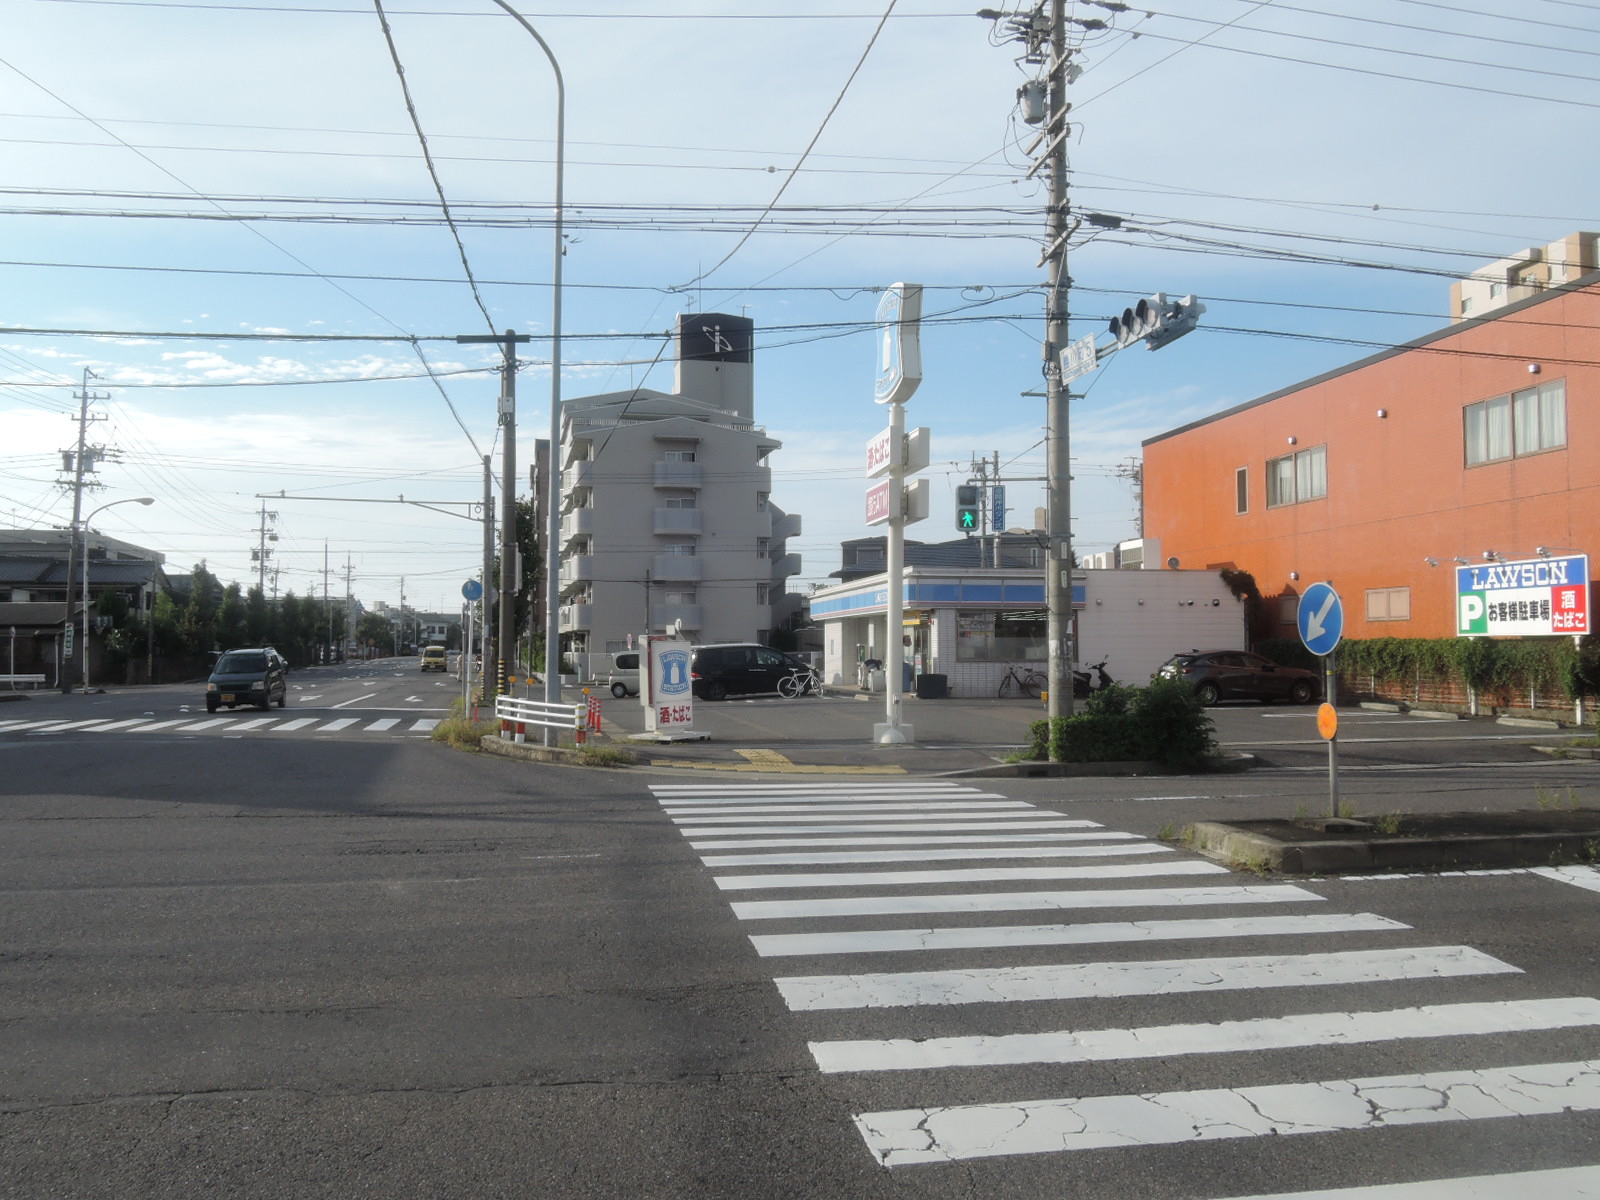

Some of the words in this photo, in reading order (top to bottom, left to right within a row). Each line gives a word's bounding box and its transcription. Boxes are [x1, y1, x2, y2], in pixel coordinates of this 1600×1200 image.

[1472, 561, 1568, 590] LAWSON
[1561, 590, 1575, 609] 酒
[1460, 595, 1483, 630] P
[1488, 600, 1550, 622] お客様駐車場
[1553, 612, 1585, 628] たばこ
